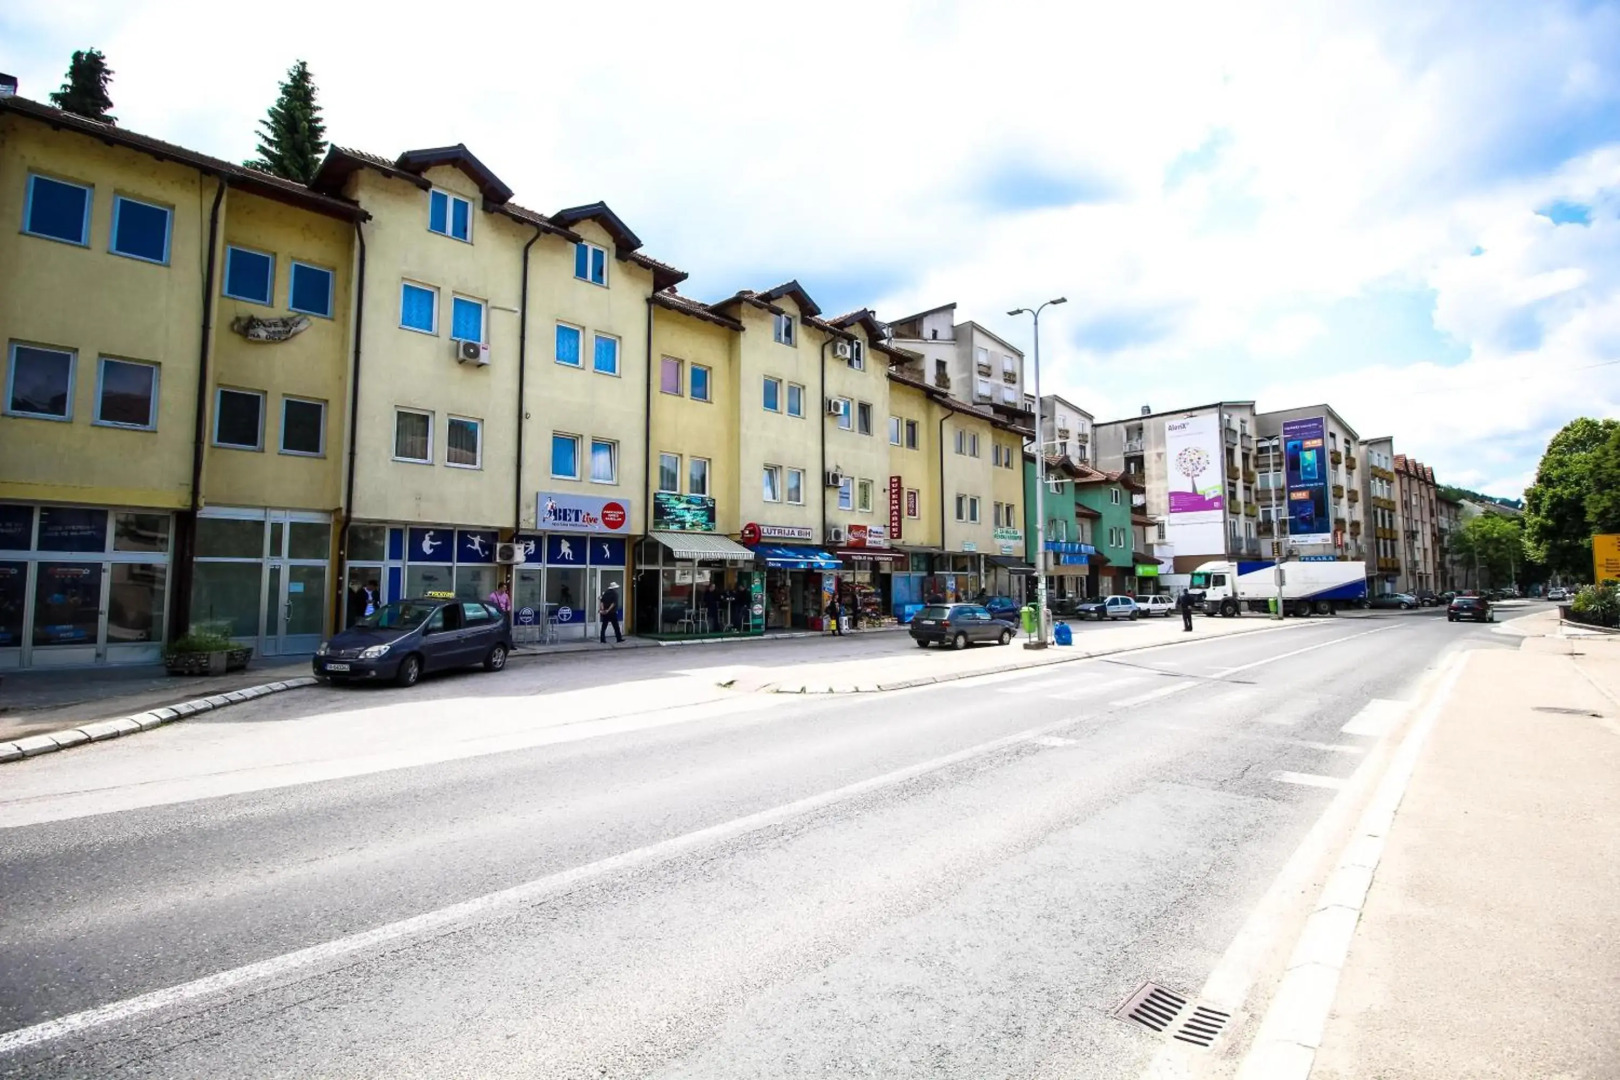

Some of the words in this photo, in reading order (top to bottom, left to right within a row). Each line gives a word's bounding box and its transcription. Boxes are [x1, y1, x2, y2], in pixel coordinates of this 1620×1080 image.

[891, 477, 899, 538] SUPERMARKET
[552, 508, 582, 522] BET
[582, 512, 598, 524] Live
[761, 527, 796, 537] LUTRIJA
[797, 529, 811, 537] BiH
